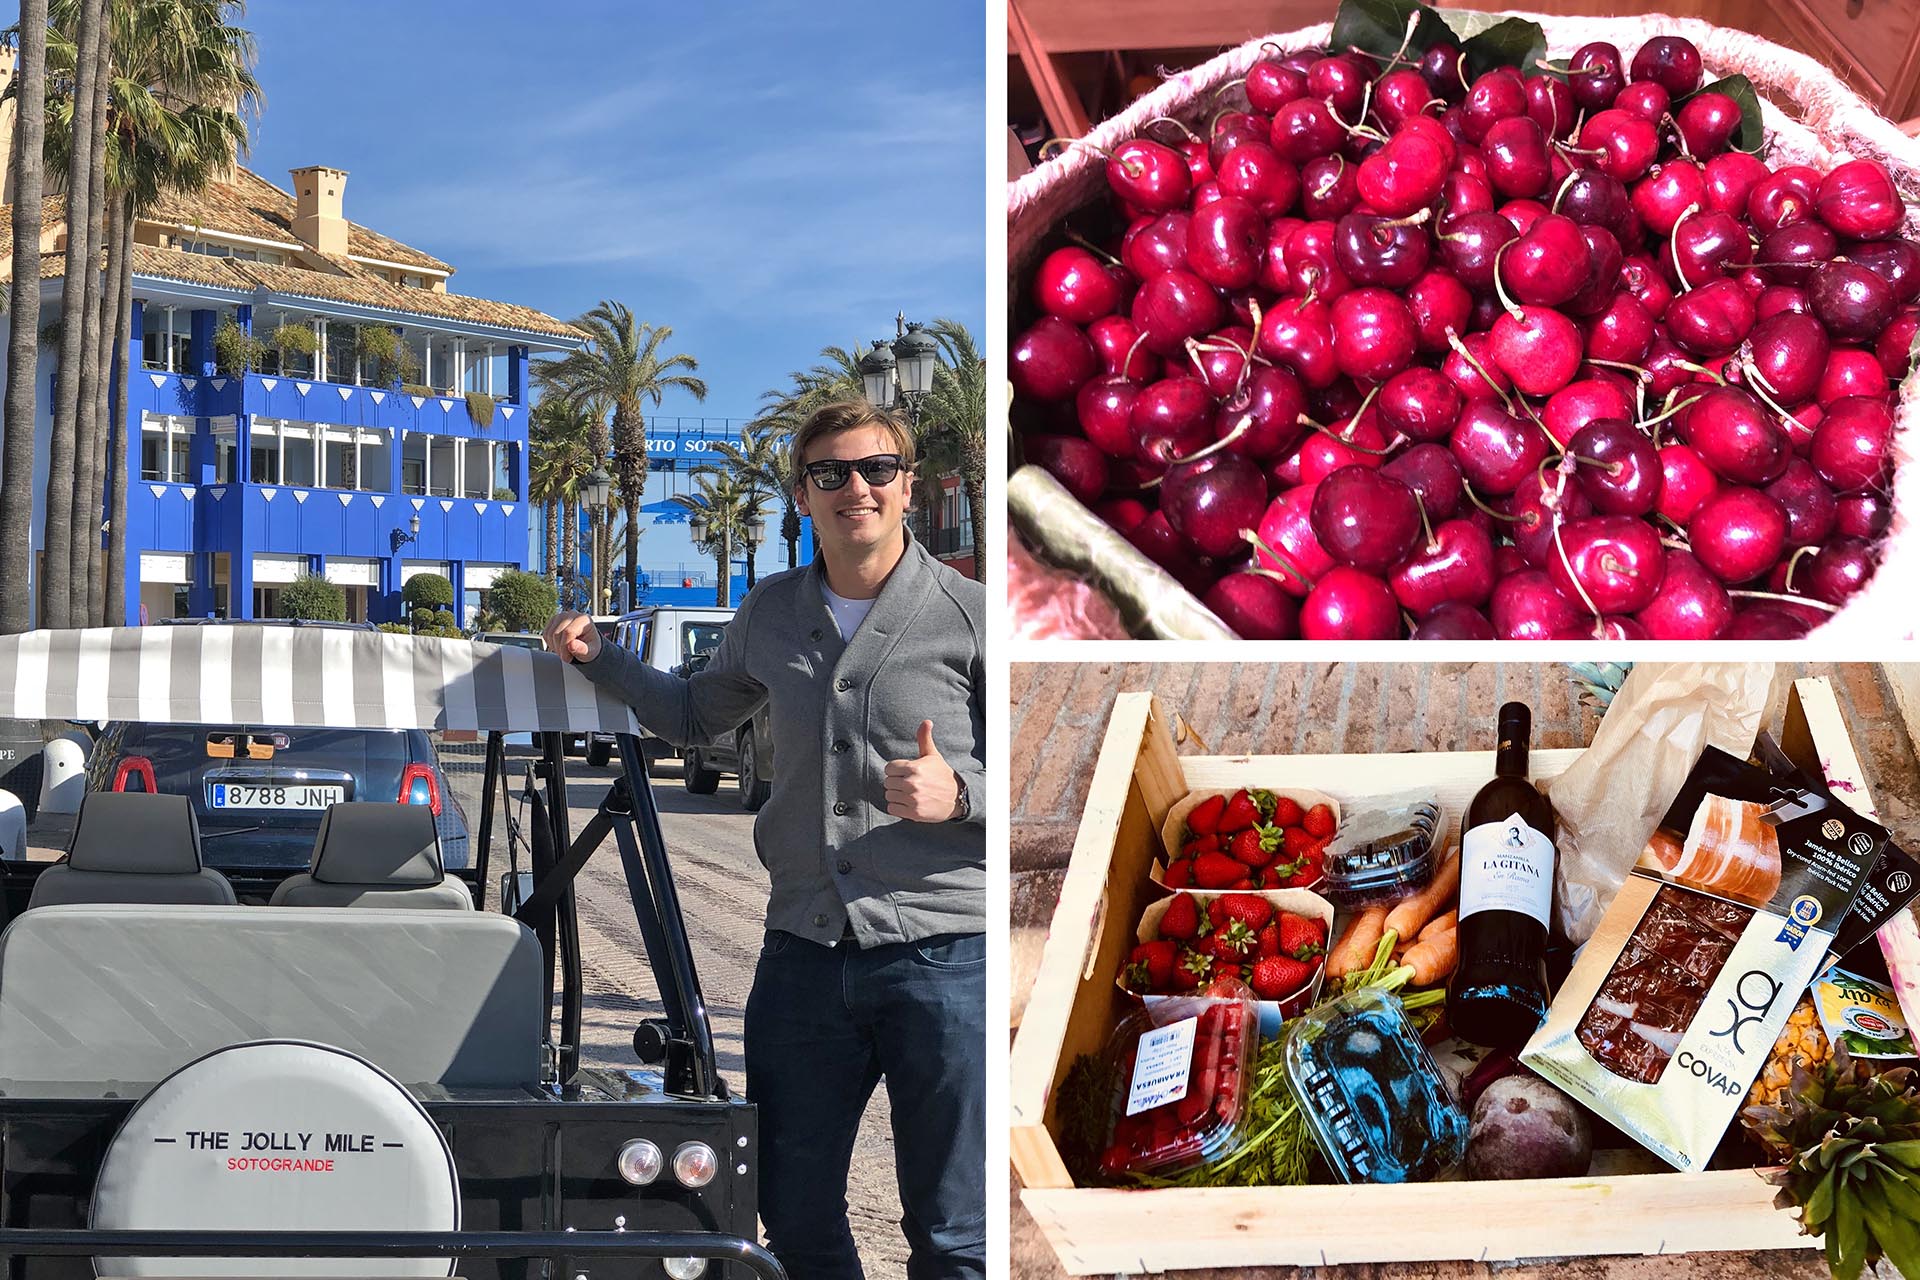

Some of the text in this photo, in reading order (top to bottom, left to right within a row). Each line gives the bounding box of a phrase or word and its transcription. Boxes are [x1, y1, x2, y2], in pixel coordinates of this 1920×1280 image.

[645, 439, 676, 453] RTO
[230, 787, 337, 807] 8788 JNH
[1804, 839, 1828, 855] Jamón
[1827, 850, 1837, 860] de
[1836, 855, 1861, 873] Bellota
[1812, 852, 1857, 879] 100% Ibérico
[1483, 859, 1540, 878] LA GITANA
[1836, 881, 1849, 893] Ham
[1869, 884, 1891, 907] Bellota
[1784, 923, 1806, 939] SABOR
[1838, 989, 1872, 1006] air
[1677, 1051, 1742, 1097] COVAP
[186, 1131, 375, 1153] THE JOLLY MILE
[227, 1157, 335, 1172] SOTOGRANDE
[1677, 1150, 1692, 1168] 70g
